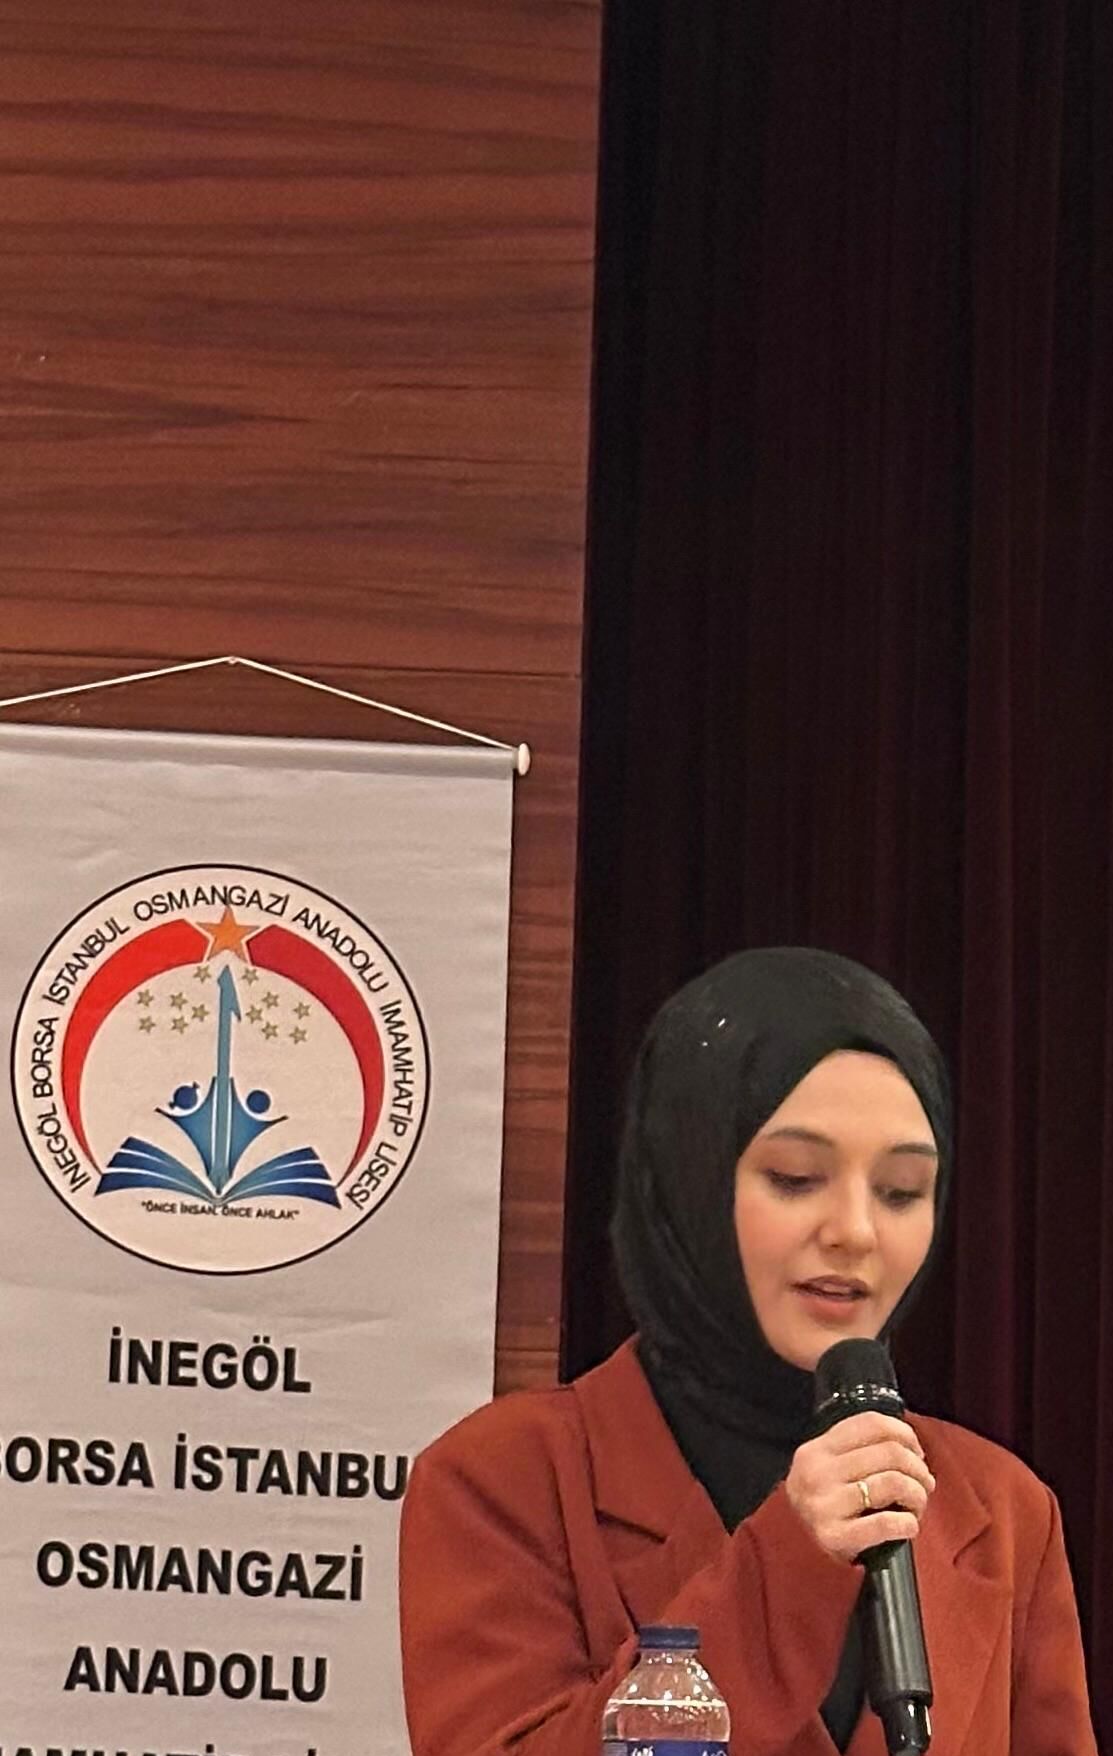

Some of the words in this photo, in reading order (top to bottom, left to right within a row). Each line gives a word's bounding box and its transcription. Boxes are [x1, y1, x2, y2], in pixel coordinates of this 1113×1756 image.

[31, 1017, 59, 1098] BORSA
[133, 885, 290, 921] OSMANGAZİ
[292, 907, 389, 993] ANADOLU
[108, 1326, 312, 1393] İNEGÖL
[0, 1436, 154, 1488] ORSA
[173, 1433, 409, 1501] İSTANBU
[36, 1541, 364, 1601] OSMANGAZİ
[63, 1645, 328, 1703] ANADOLU
